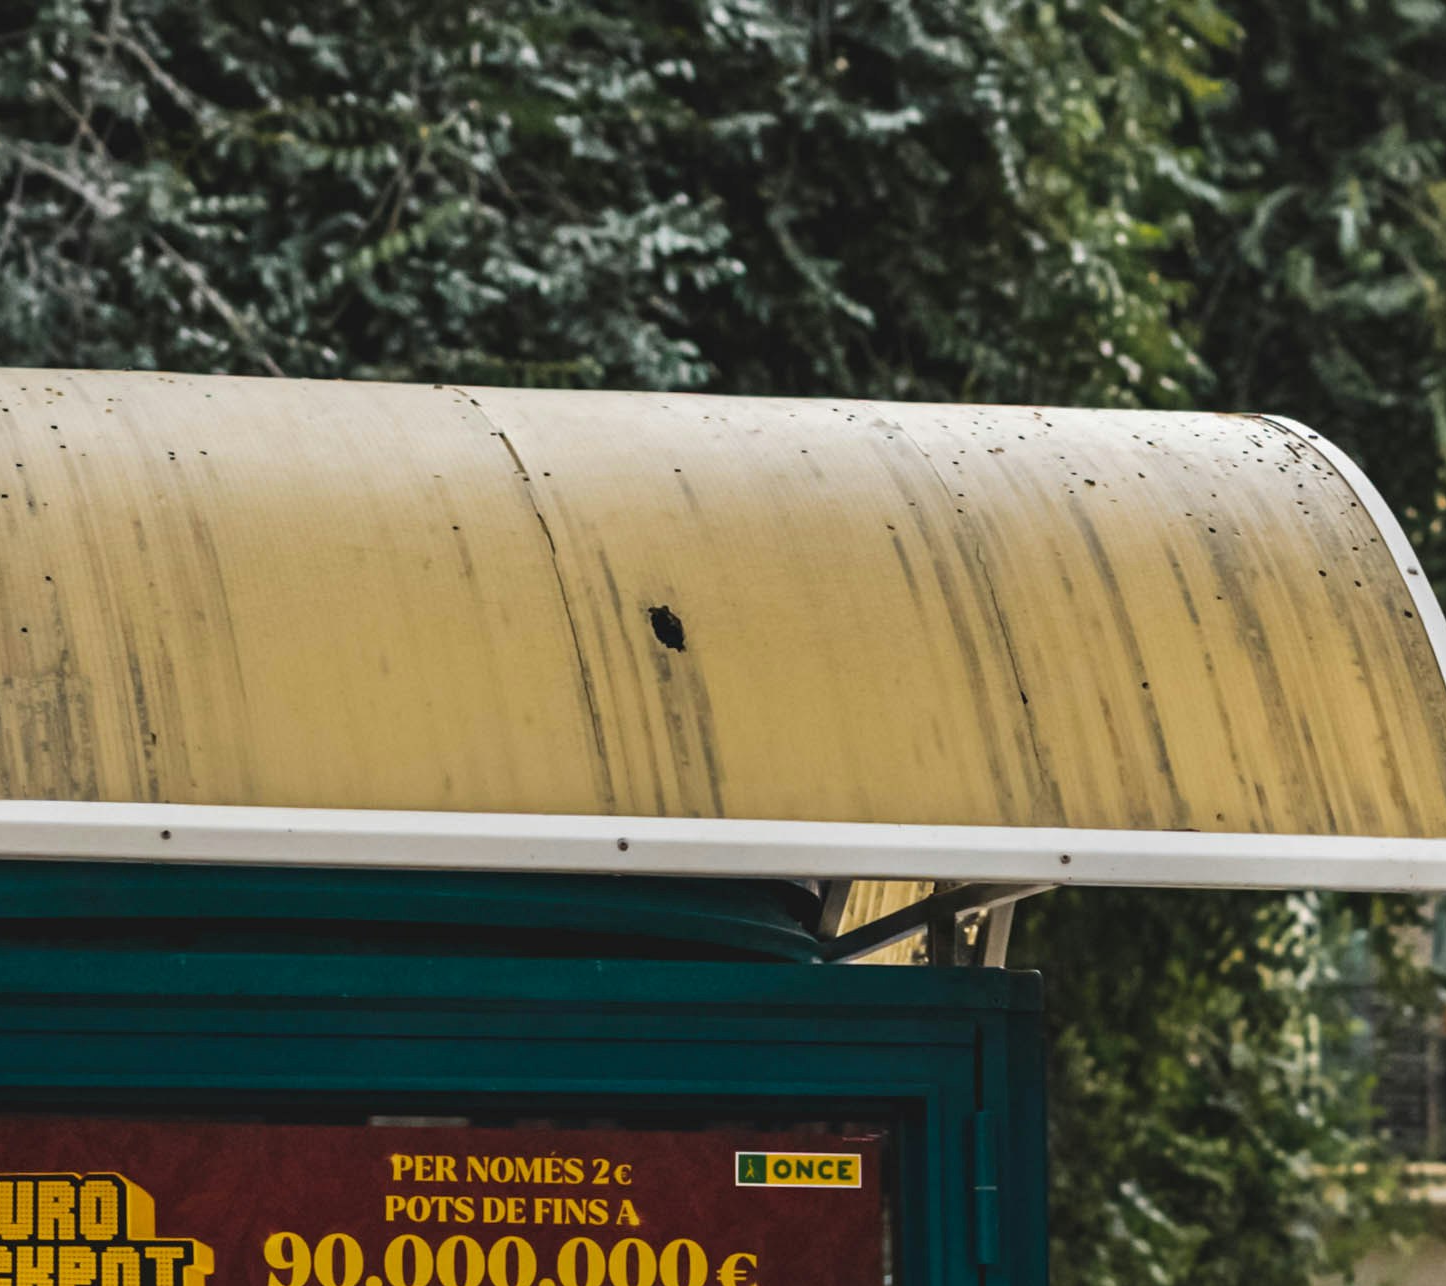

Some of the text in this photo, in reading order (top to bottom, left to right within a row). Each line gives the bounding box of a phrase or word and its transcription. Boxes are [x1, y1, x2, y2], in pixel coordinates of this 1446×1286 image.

[391, 1154, 458, 1183] PER
[465, 1152, 585, 1185] NOMÉS
[772, 1159, 854, 1182] ONCE
[385, 1195, 640, 1226] POTS DE FINS A
